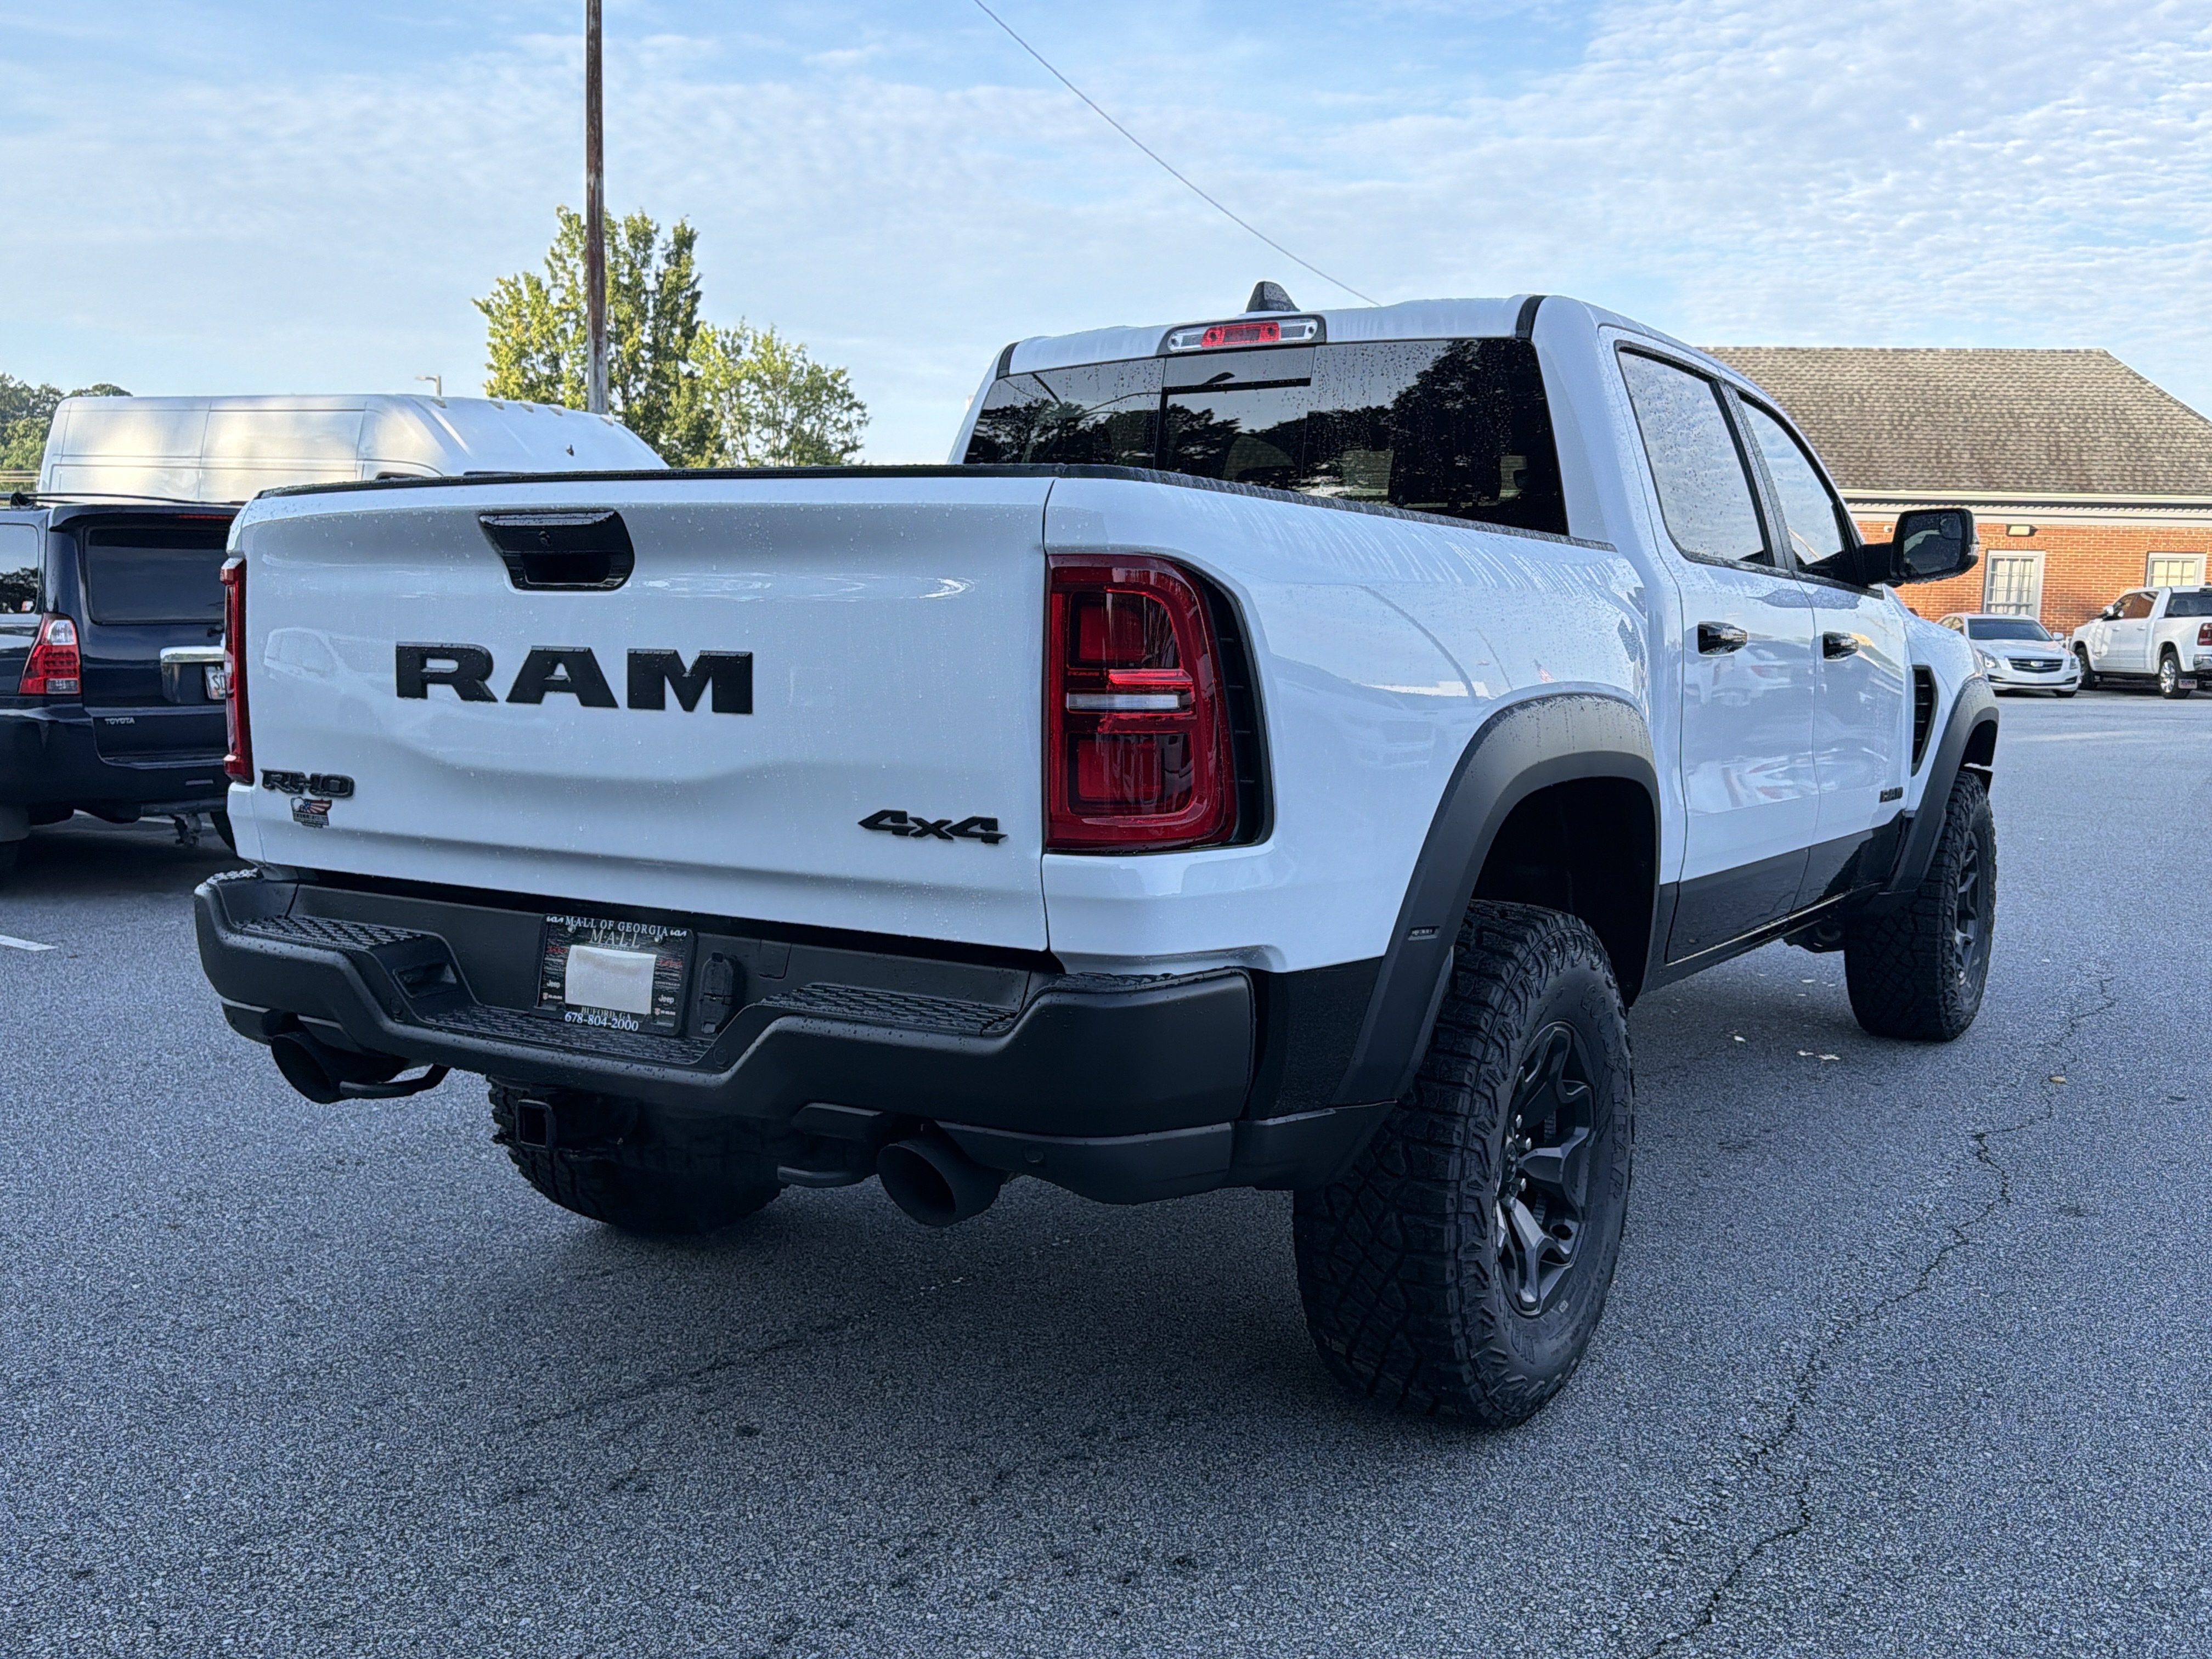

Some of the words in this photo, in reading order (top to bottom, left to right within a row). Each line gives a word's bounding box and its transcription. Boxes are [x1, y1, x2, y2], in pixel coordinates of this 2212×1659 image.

[396, 641, 753, 714] RAM
[600, 919, 614, 930] OF
[617, 922, 669, 936] GEORGIA
[546, 979, 561, 989] Jeep
[658, 994, 675, 1005] Jeep
[565, 1012, 639, 1031] 678-804-2000
